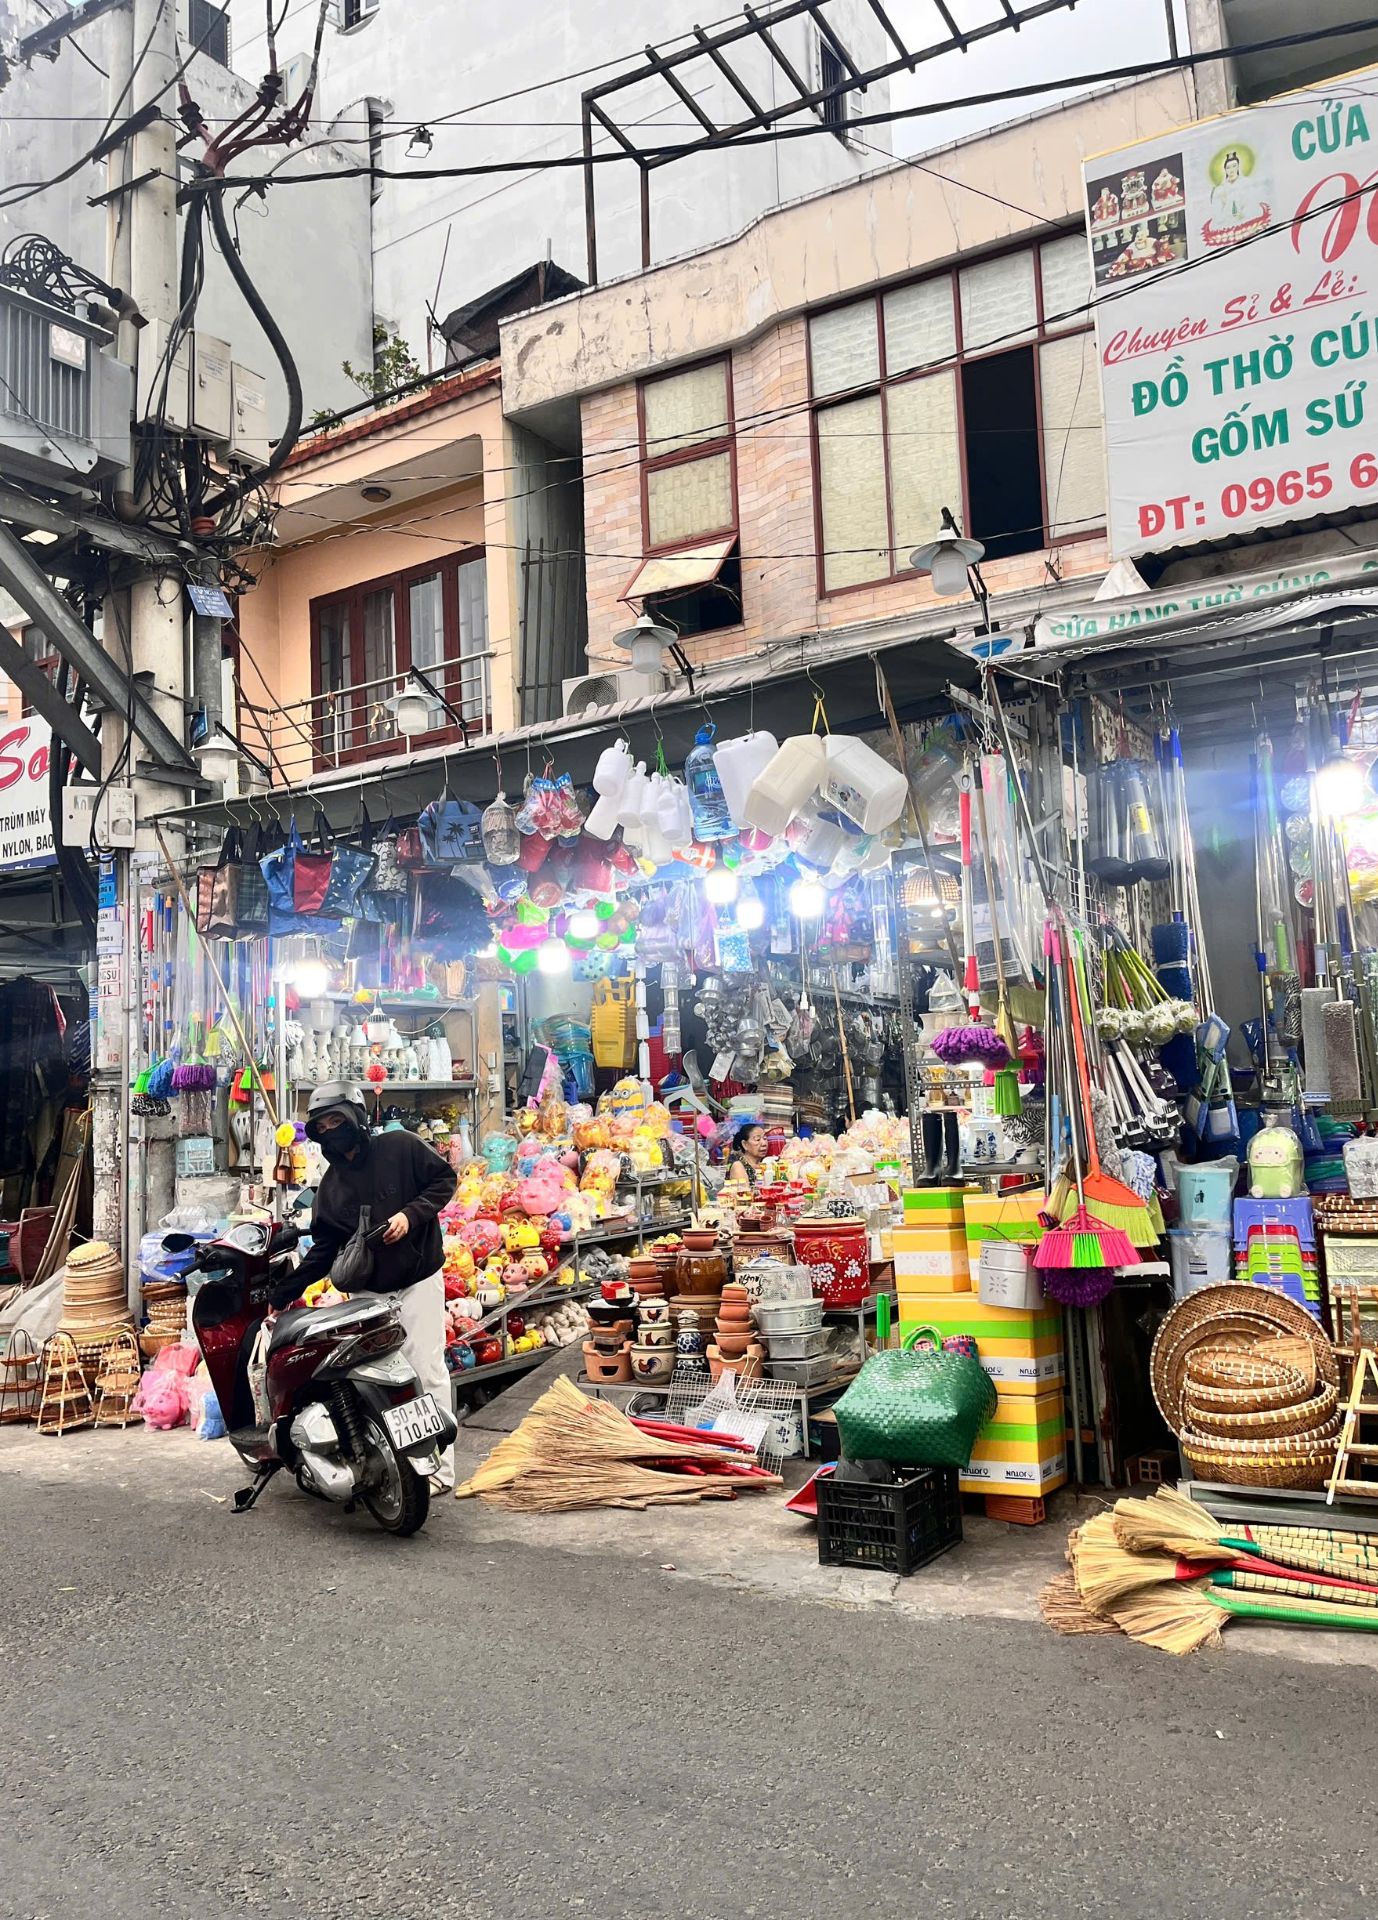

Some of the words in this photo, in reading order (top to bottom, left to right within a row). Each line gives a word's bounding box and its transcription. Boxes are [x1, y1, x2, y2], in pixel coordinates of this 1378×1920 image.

[1291, 99, 1370, 160] CỬA
[1103, 317, 1208, 366] Chuyên
[1220, 293, 1259, 328] Sỉ
[1269, 283, 1292, 314] &
[1131, 355, 1189, 417] ĐỒ
[1204, 334, 1295, 396] THỜ
[1191, 402, 1290, 465] GỐM
[1305, 380, 1368, 437] SỨ
[1138, 495, 1206, 538] ĐT:
[1220, 462, 1333, 519] 0965
[26, 805, 46, 826] MÁY
[2, 838, 33, 858] NYLON,
[394, 1415, 441, 1447] 710.40
[1005, 1470, 1027, 1478] JOTUN
